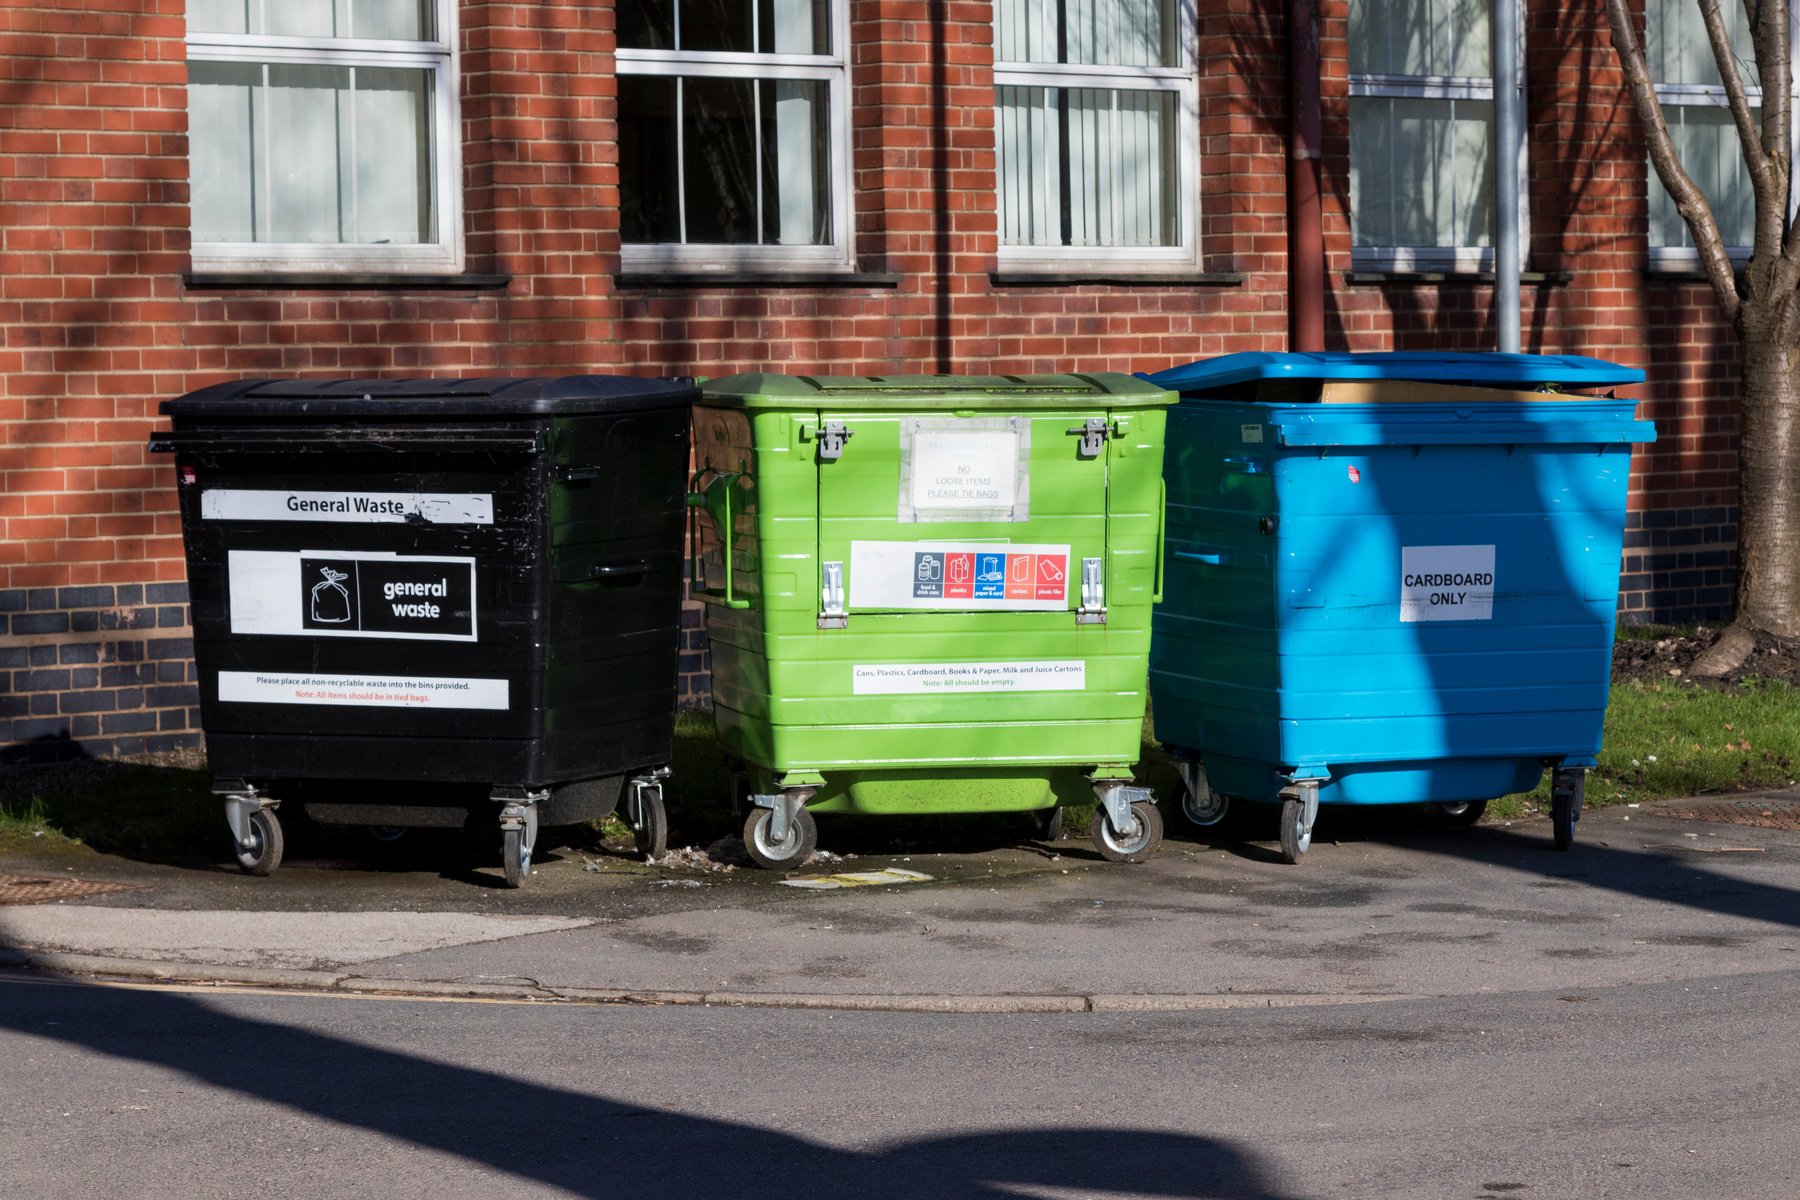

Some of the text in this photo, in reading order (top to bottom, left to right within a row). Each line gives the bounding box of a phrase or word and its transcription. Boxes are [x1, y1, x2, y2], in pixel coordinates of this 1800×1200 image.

[958, 465, 971, 474] NO
[936, 477, 992, 486] LOOSE ITEMS
[928, 489, 999, 499] PLEASE TIE BAGS
[286, 495, 404, 514] General Waste
[1404, 573, 1493, 587] CARDBOARD
[383, 578, 447, 600] general
[1430, 592, 1466, 605] ONLY
[391, 601, 440, 618] waste
[877, 669, 906, 677] Plastics,
[907, 668, 947, 676] Cardboard,
[949, 667, 971, 675] Books
[972, 667, 978, 675] &
[979, 667, 1001, 675] Paper,
[256, 676, 280, 684] Please
[281, 678, 300, 686] place
[312, 679, 364, 688] non-recyclable
[388, 680, 404, 688] into
[418, 681, 434, 689] bins
[435, 682, 471, 690] provided.
[991, 679, 1016, 687] empty.
[295, 690, 315, 698] Note:
[327, 691, 347, 699] items
[349, 692, 373, 700] should
[374, 692, 384, 700] be
[394, 693, 409, 701] tied
[410, 694, 430, 703] bags.
